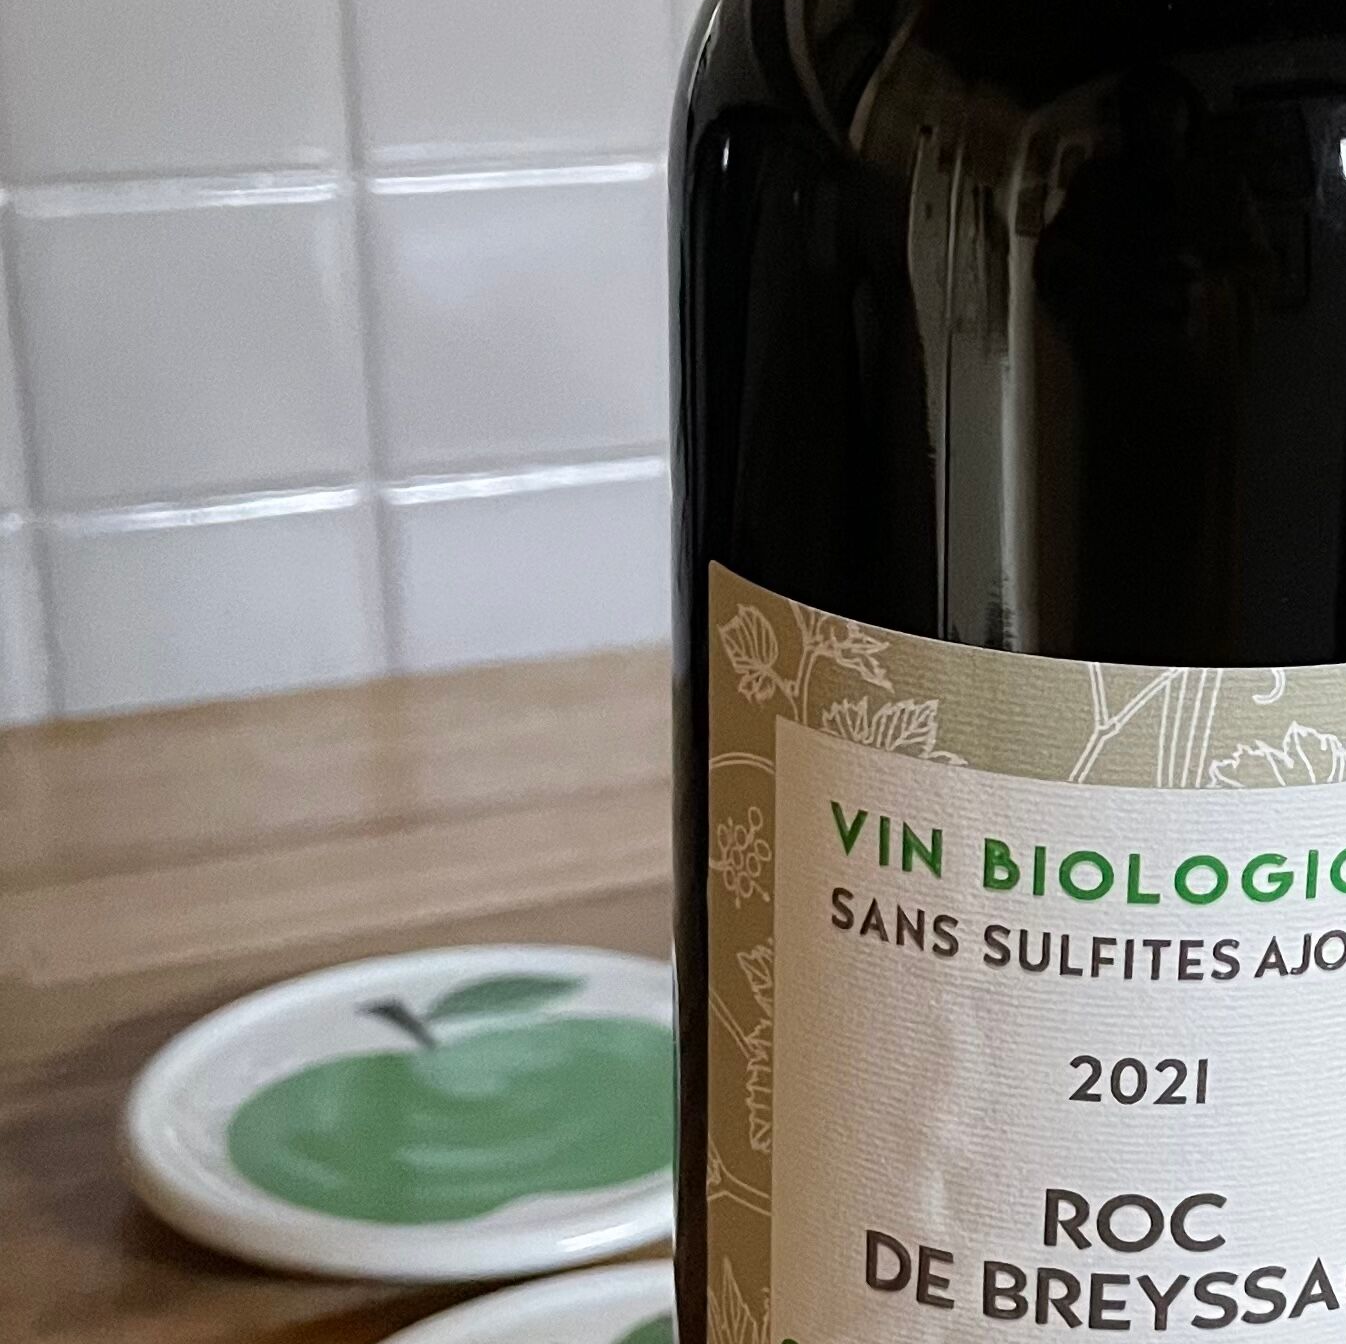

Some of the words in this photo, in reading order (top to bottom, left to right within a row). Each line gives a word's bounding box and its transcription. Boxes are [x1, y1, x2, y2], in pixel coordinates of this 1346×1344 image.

[831, 800, 943, 878] VIN
[831, 887, 960, 958] SANS
[983, 925, 1240, 980] SULFITES
[1068, 1055, 1208, 1105] 2021
[1044, 1188, 1227, 1252] ROC
[865, 1230, 954, 1309] DE
